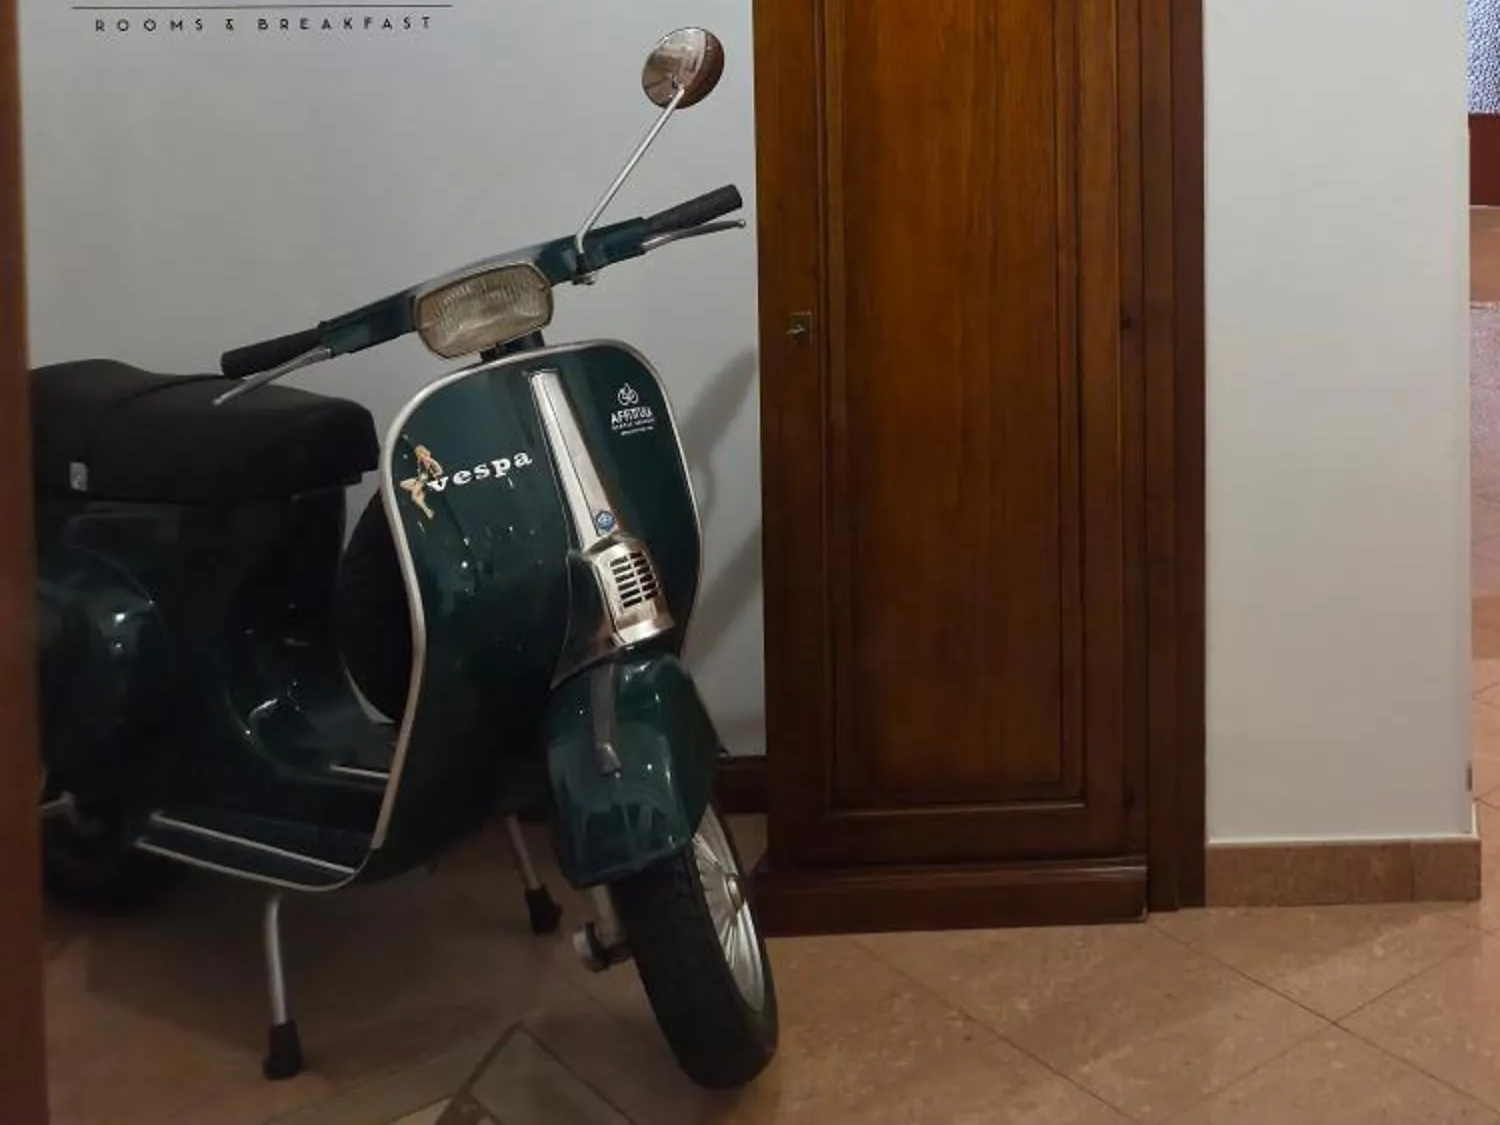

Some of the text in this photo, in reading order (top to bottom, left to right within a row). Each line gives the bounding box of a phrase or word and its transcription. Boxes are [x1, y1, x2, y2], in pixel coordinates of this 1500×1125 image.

[95, 16, 431, 32] ROOMS & BREAKFAST
[427, 452, 532, 491] vespa
